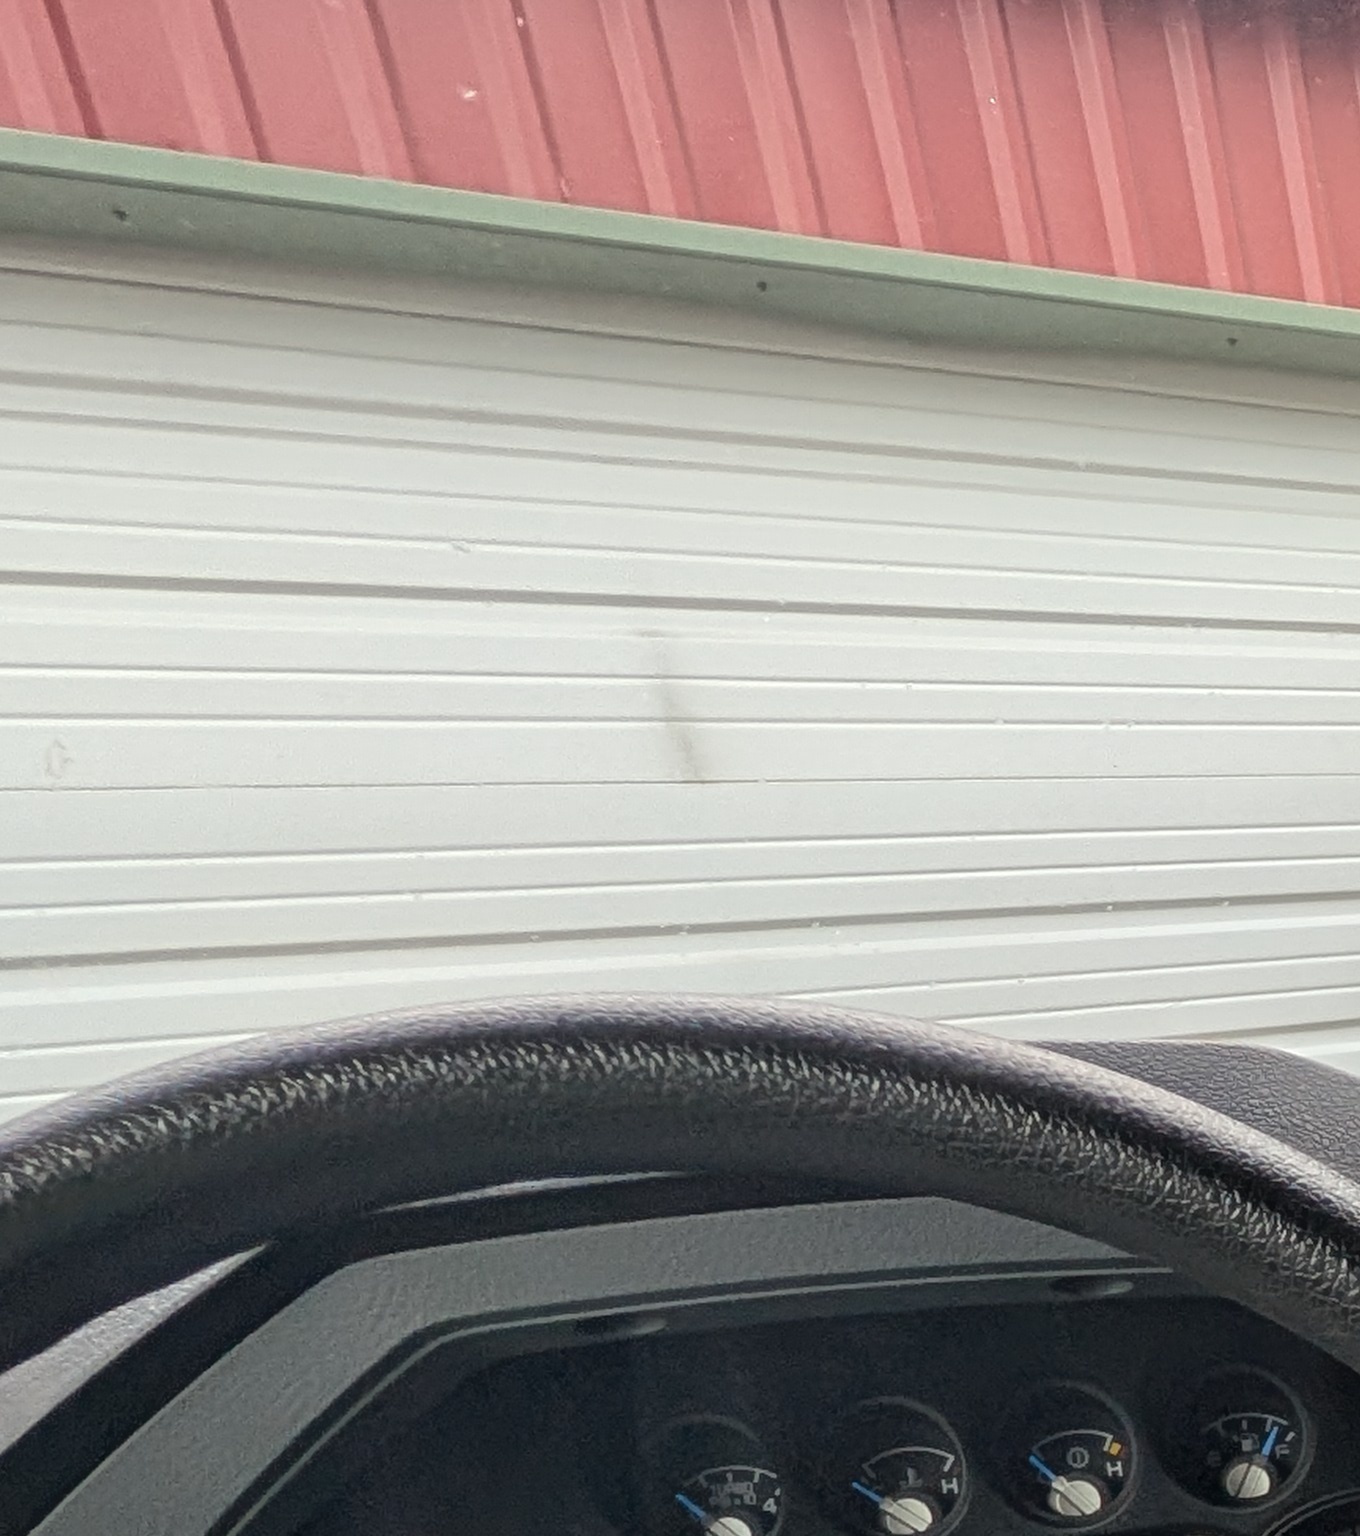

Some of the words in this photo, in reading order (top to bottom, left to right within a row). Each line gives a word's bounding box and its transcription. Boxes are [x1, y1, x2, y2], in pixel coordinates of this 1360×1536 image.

[1107, 1461, 1123, 1477] H
[942, 1478, 958, 1494] H
[762, 1498, 777, 1514] 4
